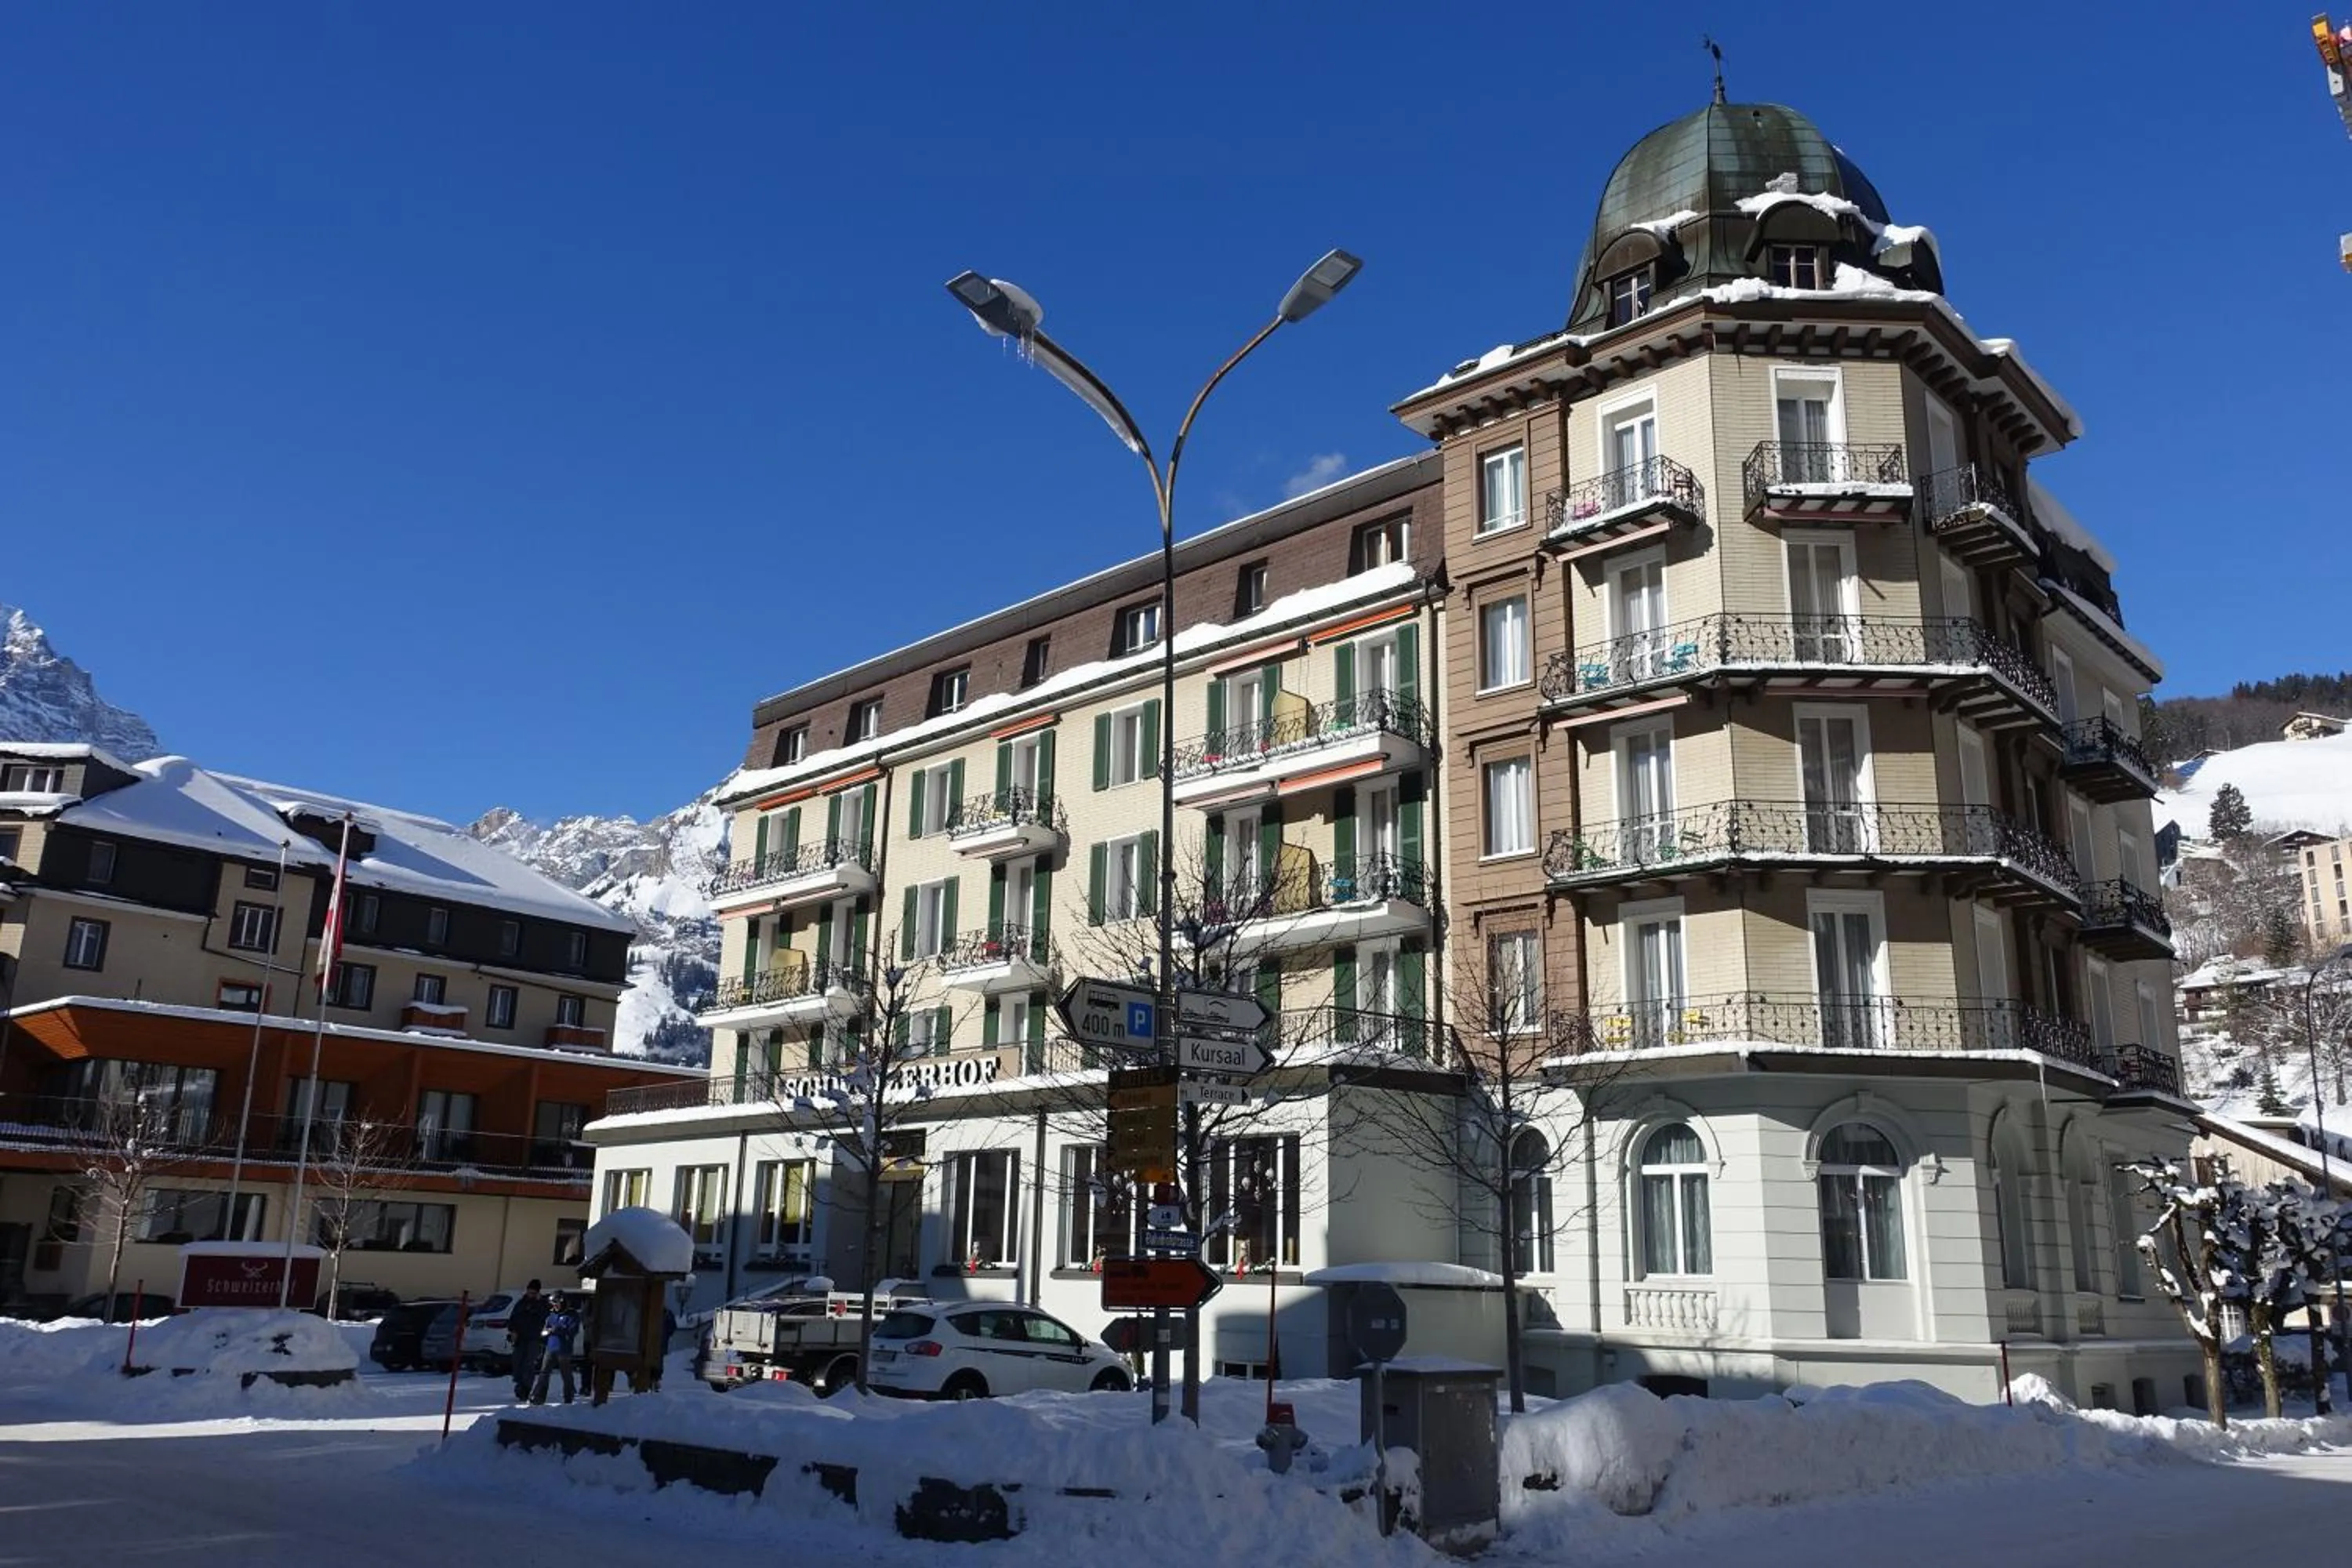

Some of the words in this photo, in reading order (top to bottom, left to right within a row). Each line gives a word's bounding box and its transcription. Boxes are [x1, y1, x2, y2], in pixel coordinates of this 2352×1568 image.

[1082, 1013, 1109, 1036] 400
[1114, 1023, 1125, 1039] m
[1134, 1009, 1145, 1029] P
[1191, 1042, 1245, 1065] Kursaal
[206, 1278, 296, 1296] Schweizerhf
